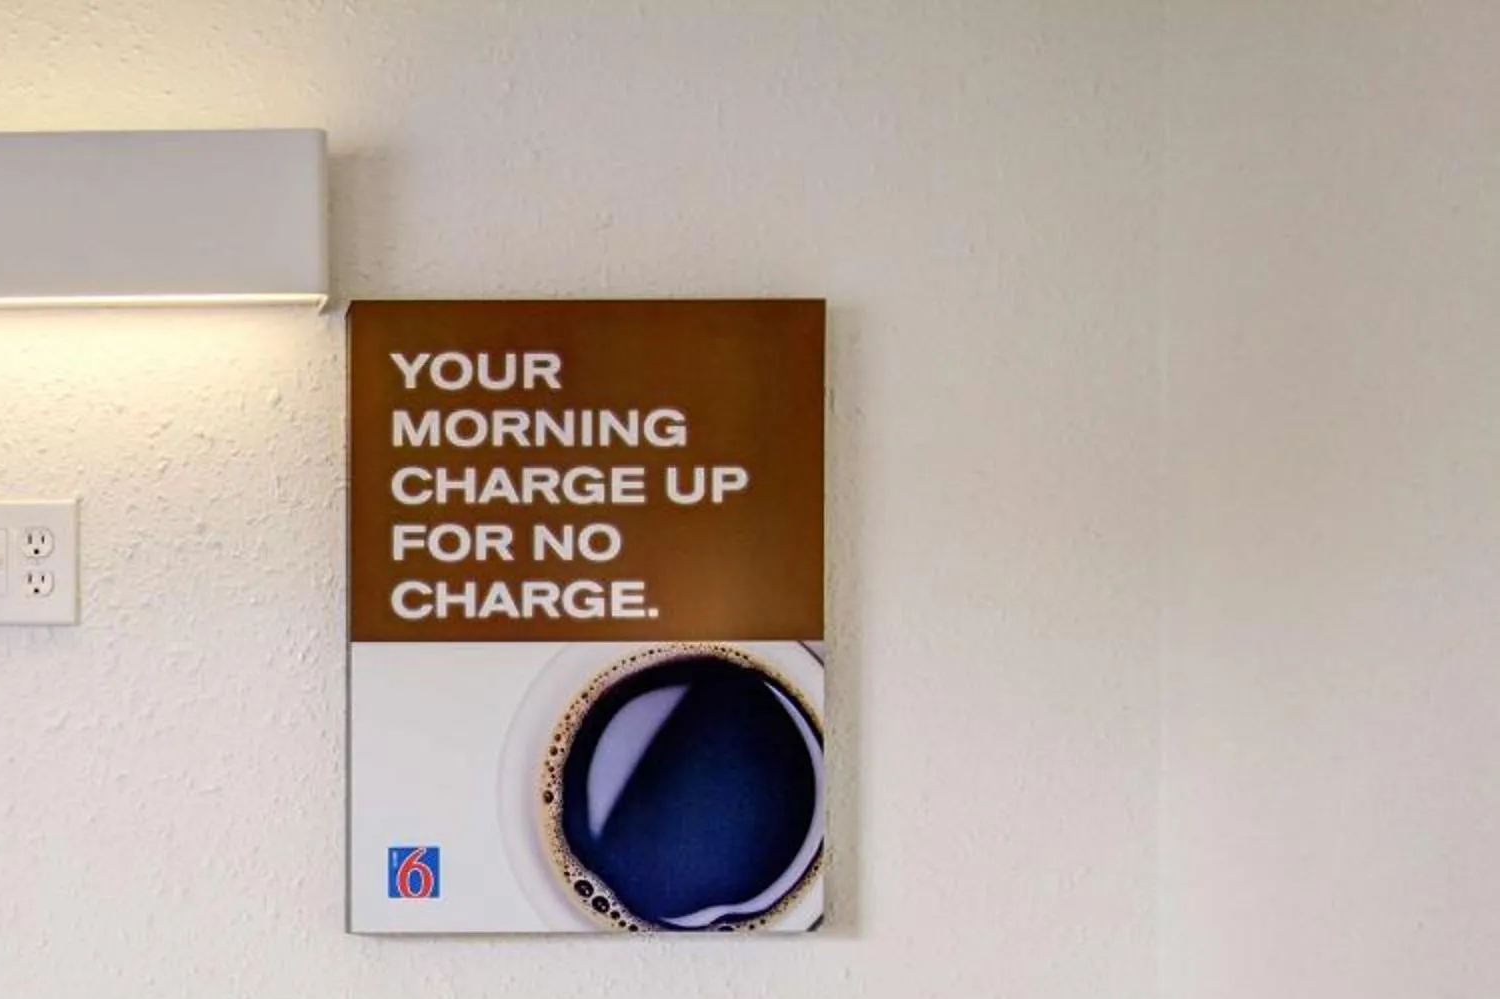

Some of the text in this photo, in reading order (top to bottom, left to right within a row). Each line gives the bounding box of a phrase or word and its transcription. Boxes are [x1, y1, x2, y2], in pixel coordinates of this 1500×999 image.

[390, 352, 562, 390] YOUR
[392, 409, 687, 447] MORNING
[391, 466, 749, 504] CHARGE UP
[392, 524, 622, 561] FOR NO
[391, 580, 659, 618] CHARGE.
[396, 847, 434, 898] 6
